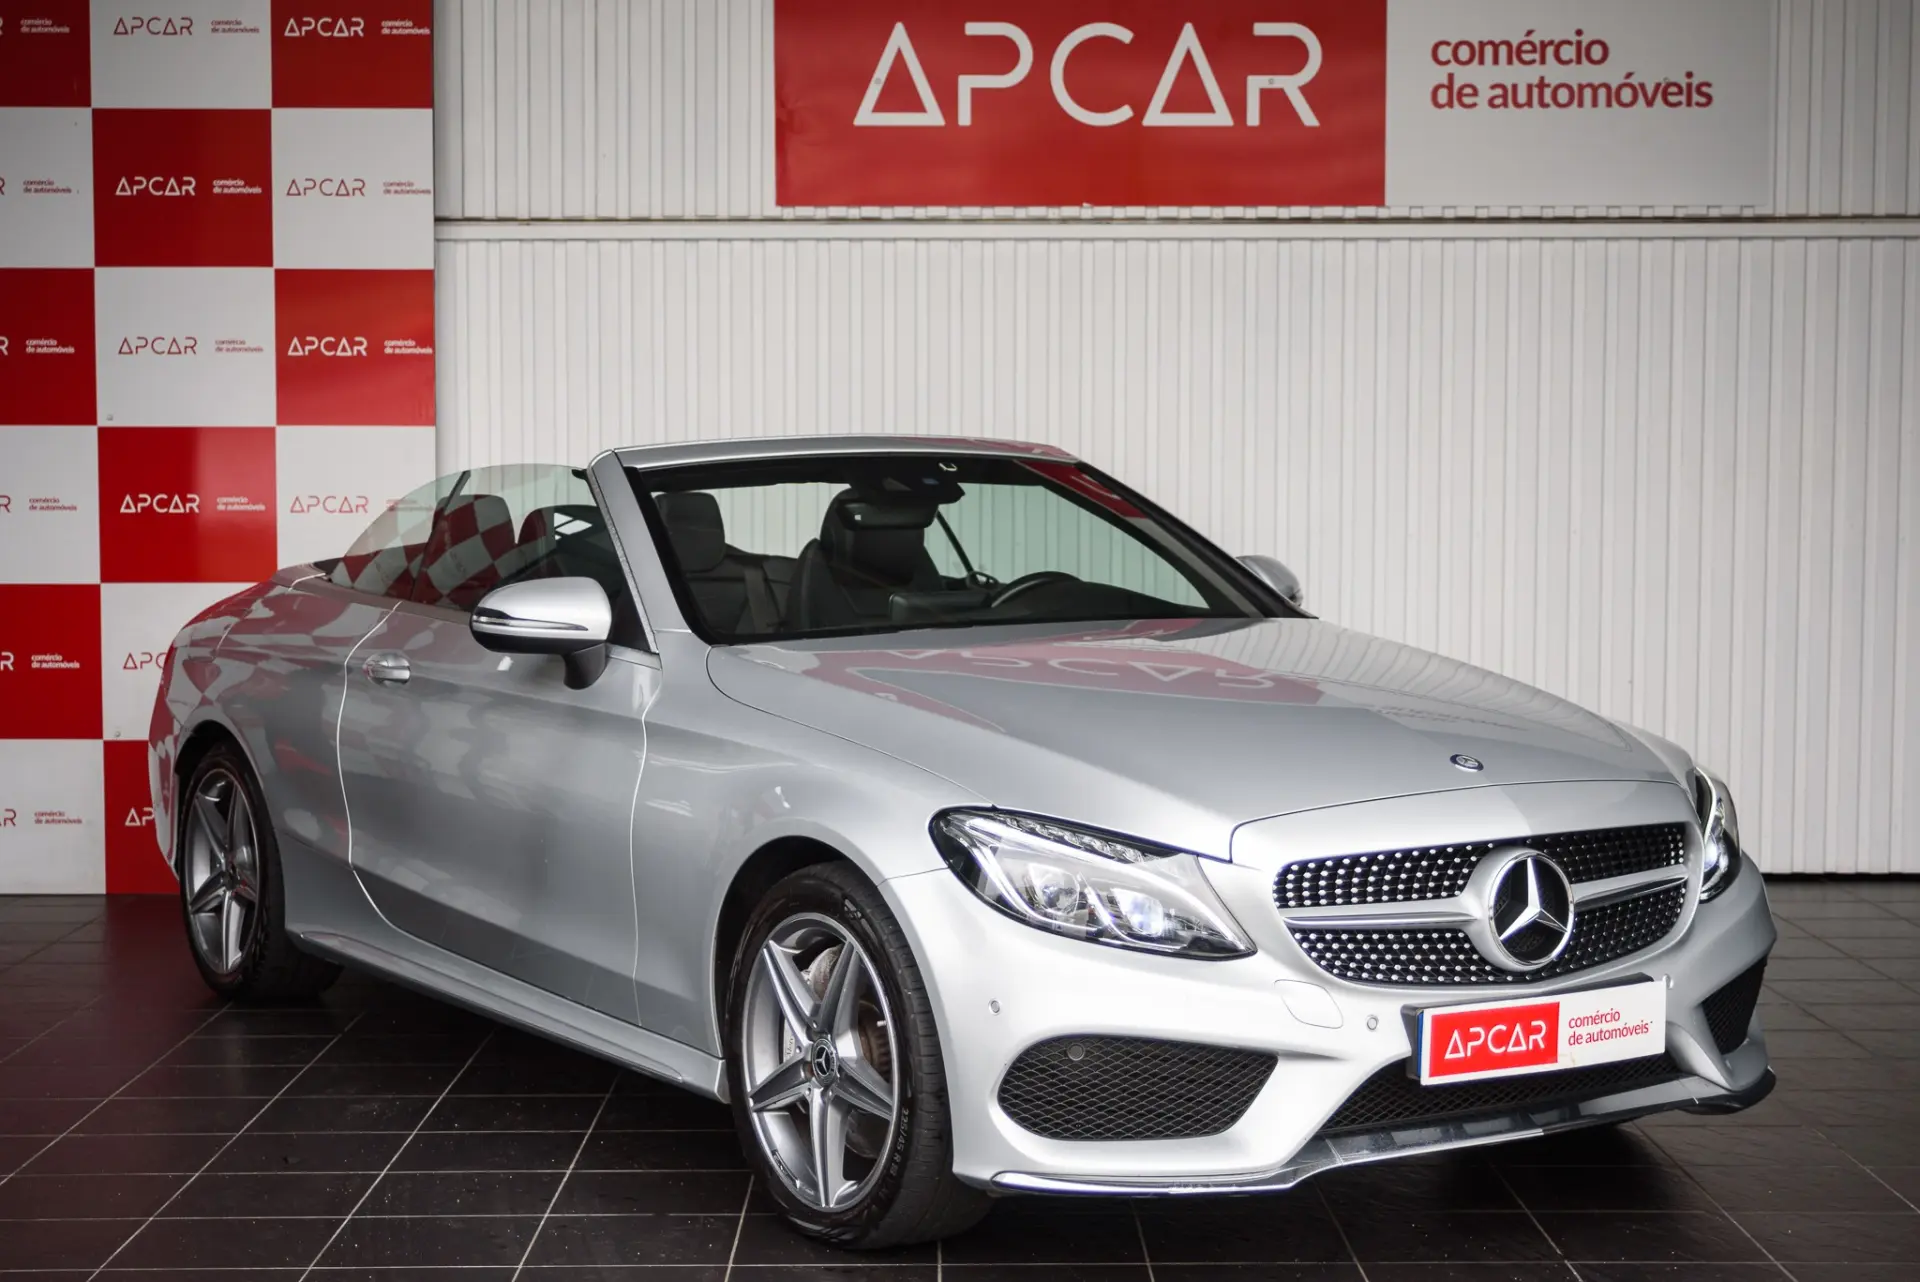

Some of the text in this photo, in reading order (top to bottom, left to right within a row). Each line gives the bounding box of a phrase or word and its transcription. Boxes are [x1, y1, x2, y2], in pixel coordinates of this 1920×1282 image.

[114, 17, 193, 36] APCAR
[284, 17, 364, 37] APCAR
[1430, 29, 1610, 66] comércio
[853, 21, 1323, 126] APCAR
[1430, 71, 1714, 109] de automóveis
[116, 177, 196, 196] APCAR
[286, 177, 365, 196] APCAR
[118, 336, 198, 355] APCAR
[288, 336, 368, 356] APCAR
[120, 494, 200, 514] APCAR
[290, 495, 368, 513] APCAR
[123, 651, 167, 670] APC
[1568, 1007, 1621, 1029] comércio
[1444, 1019, 1547, 1060] APCAR
[1568, 1020, 1649, 1046] de automóveis
